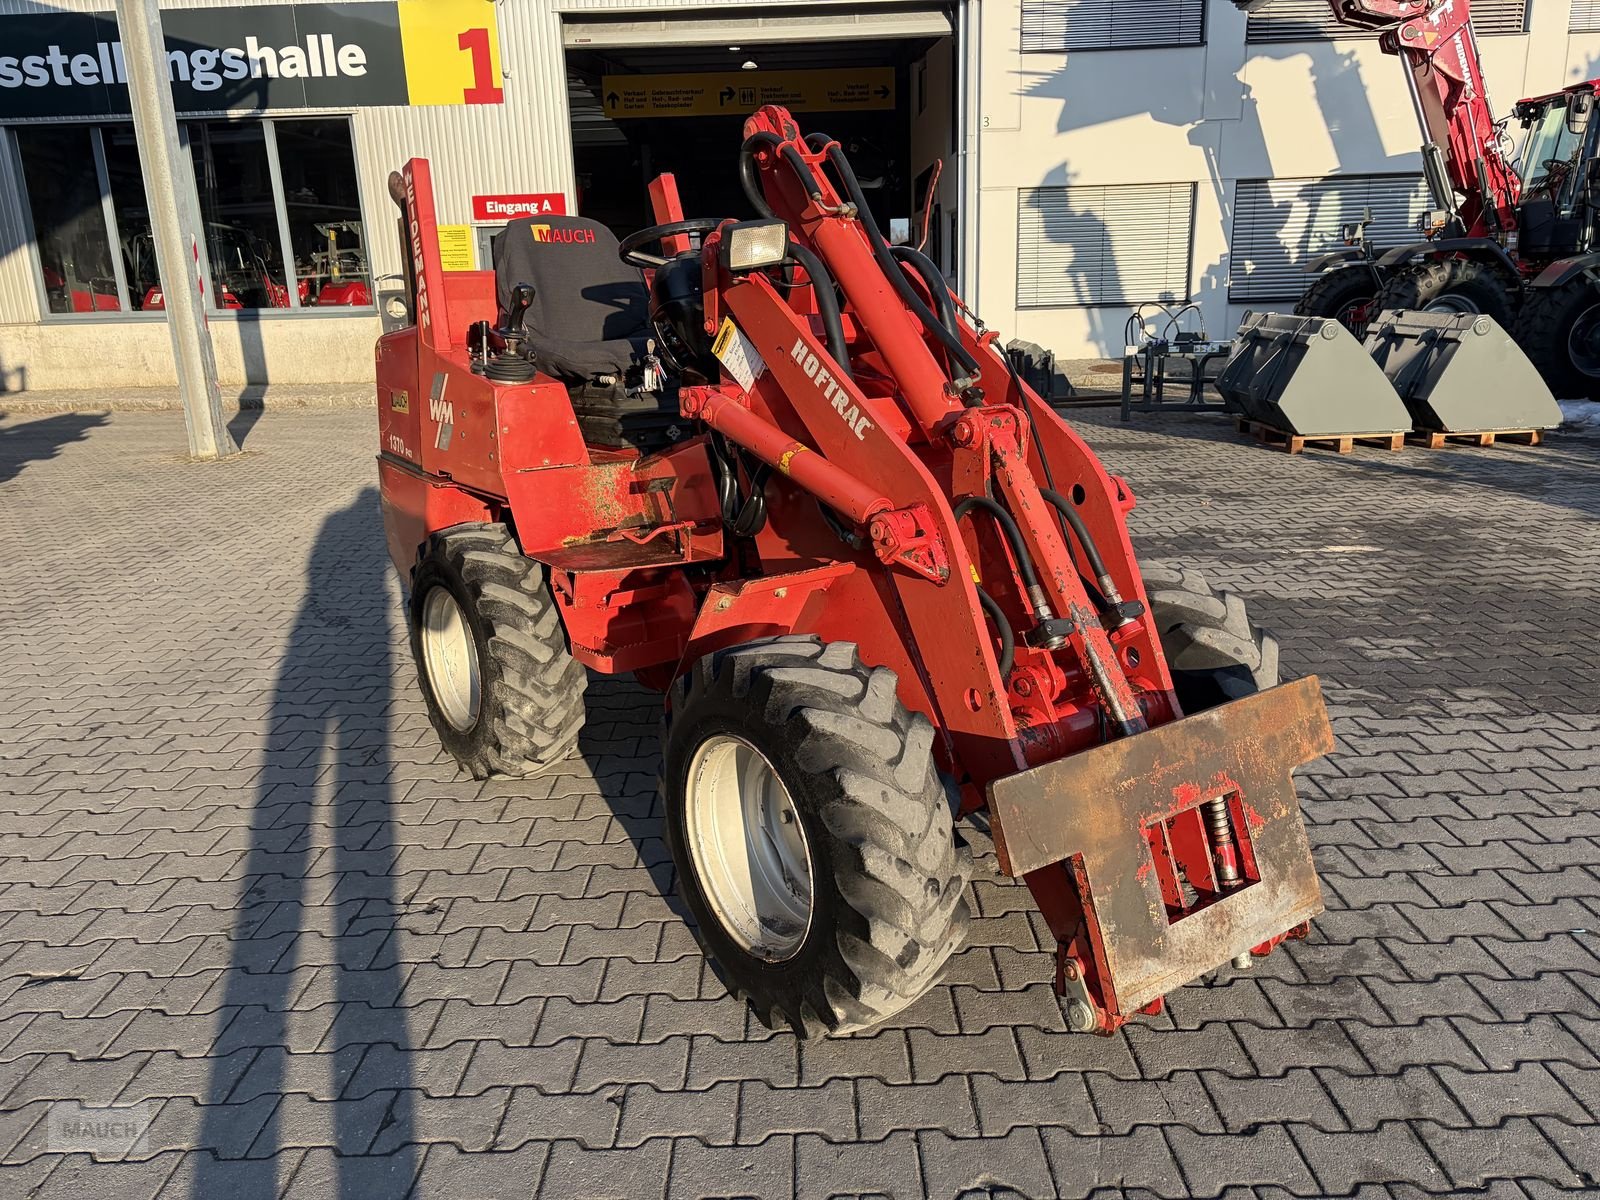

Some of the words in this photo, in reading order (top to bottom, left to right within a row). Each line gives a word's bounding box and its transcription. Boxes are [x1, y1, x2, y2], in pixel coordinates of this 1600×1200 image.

[0, 34, 367, 91] sstellngshalle
[458, 28, 504, 104] 1
[983, 116, 990, 128] 3
[485, 201, 538, 215] Eingang
[542, 199, 552, 211] A
[404, 171, 431, 329] WEIDEMANN
[538, 228, 596, 244] MAUCH
[790, 337, 872, 441] HOFTRAC
[389, 433, 405, 455] 1370
